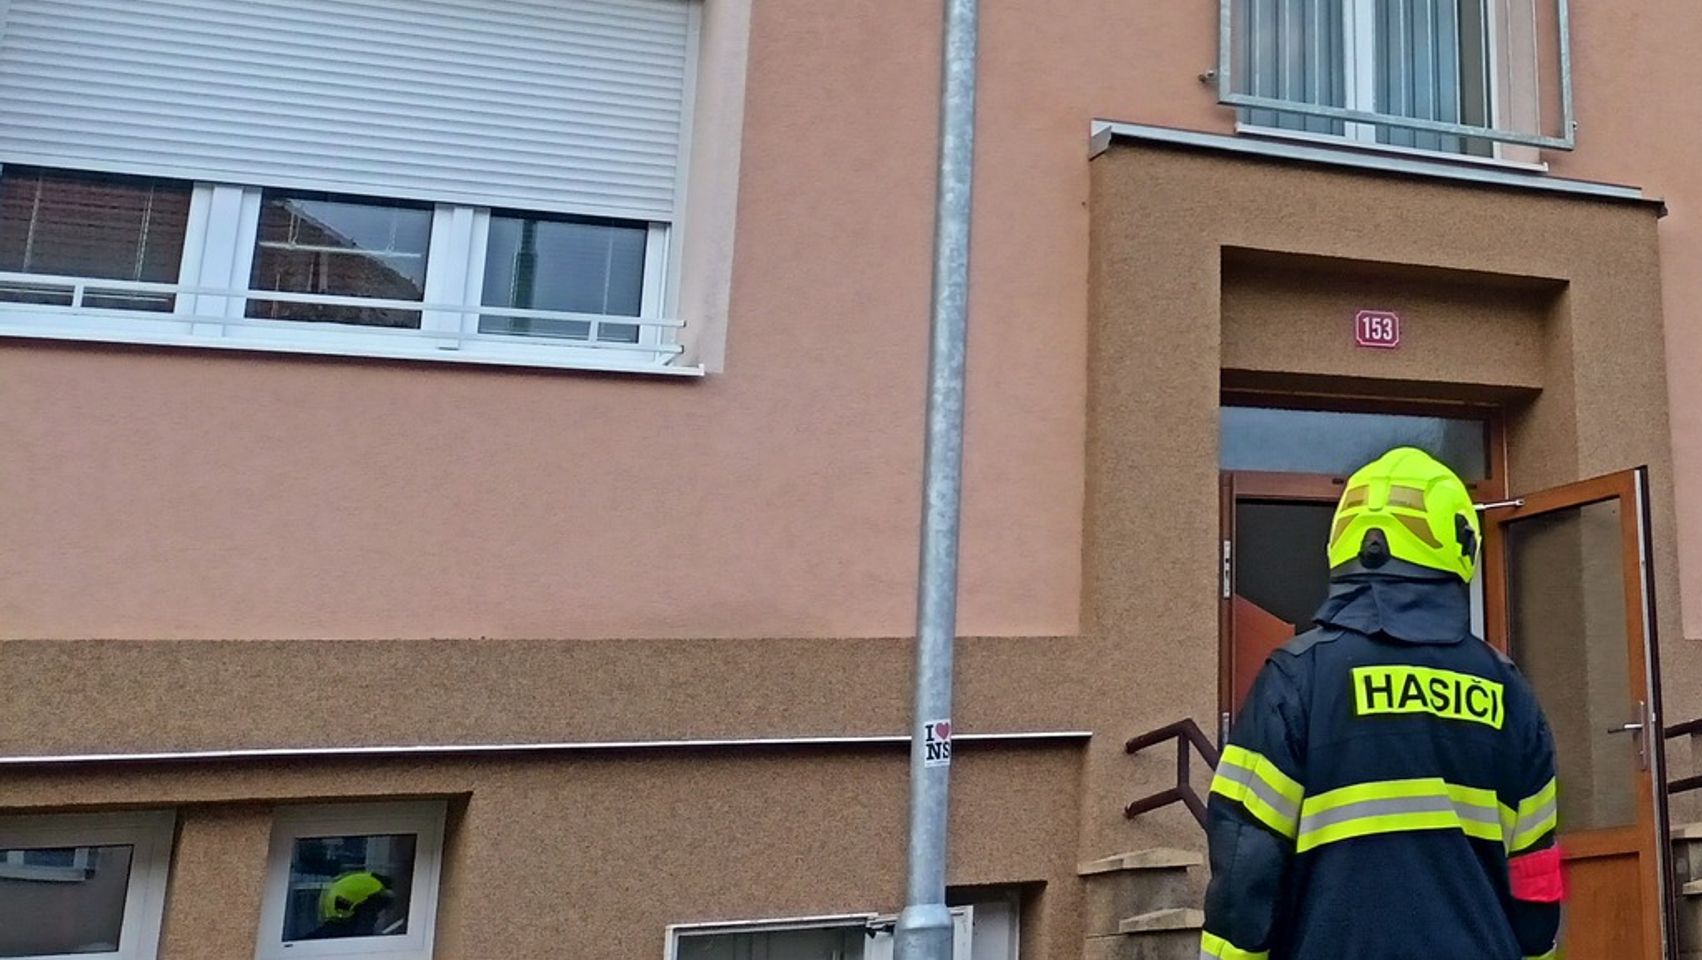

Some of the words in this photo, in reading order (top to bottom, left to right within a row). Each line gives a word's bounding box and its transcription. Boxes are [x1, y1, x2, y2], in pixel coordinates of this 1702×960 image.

[1362, 316, 1393, 340] 153
[1363, 673, 1498, 722] HASIČI
[925, 724, 935, 742] I
[926, 741, 950, 761] NS
